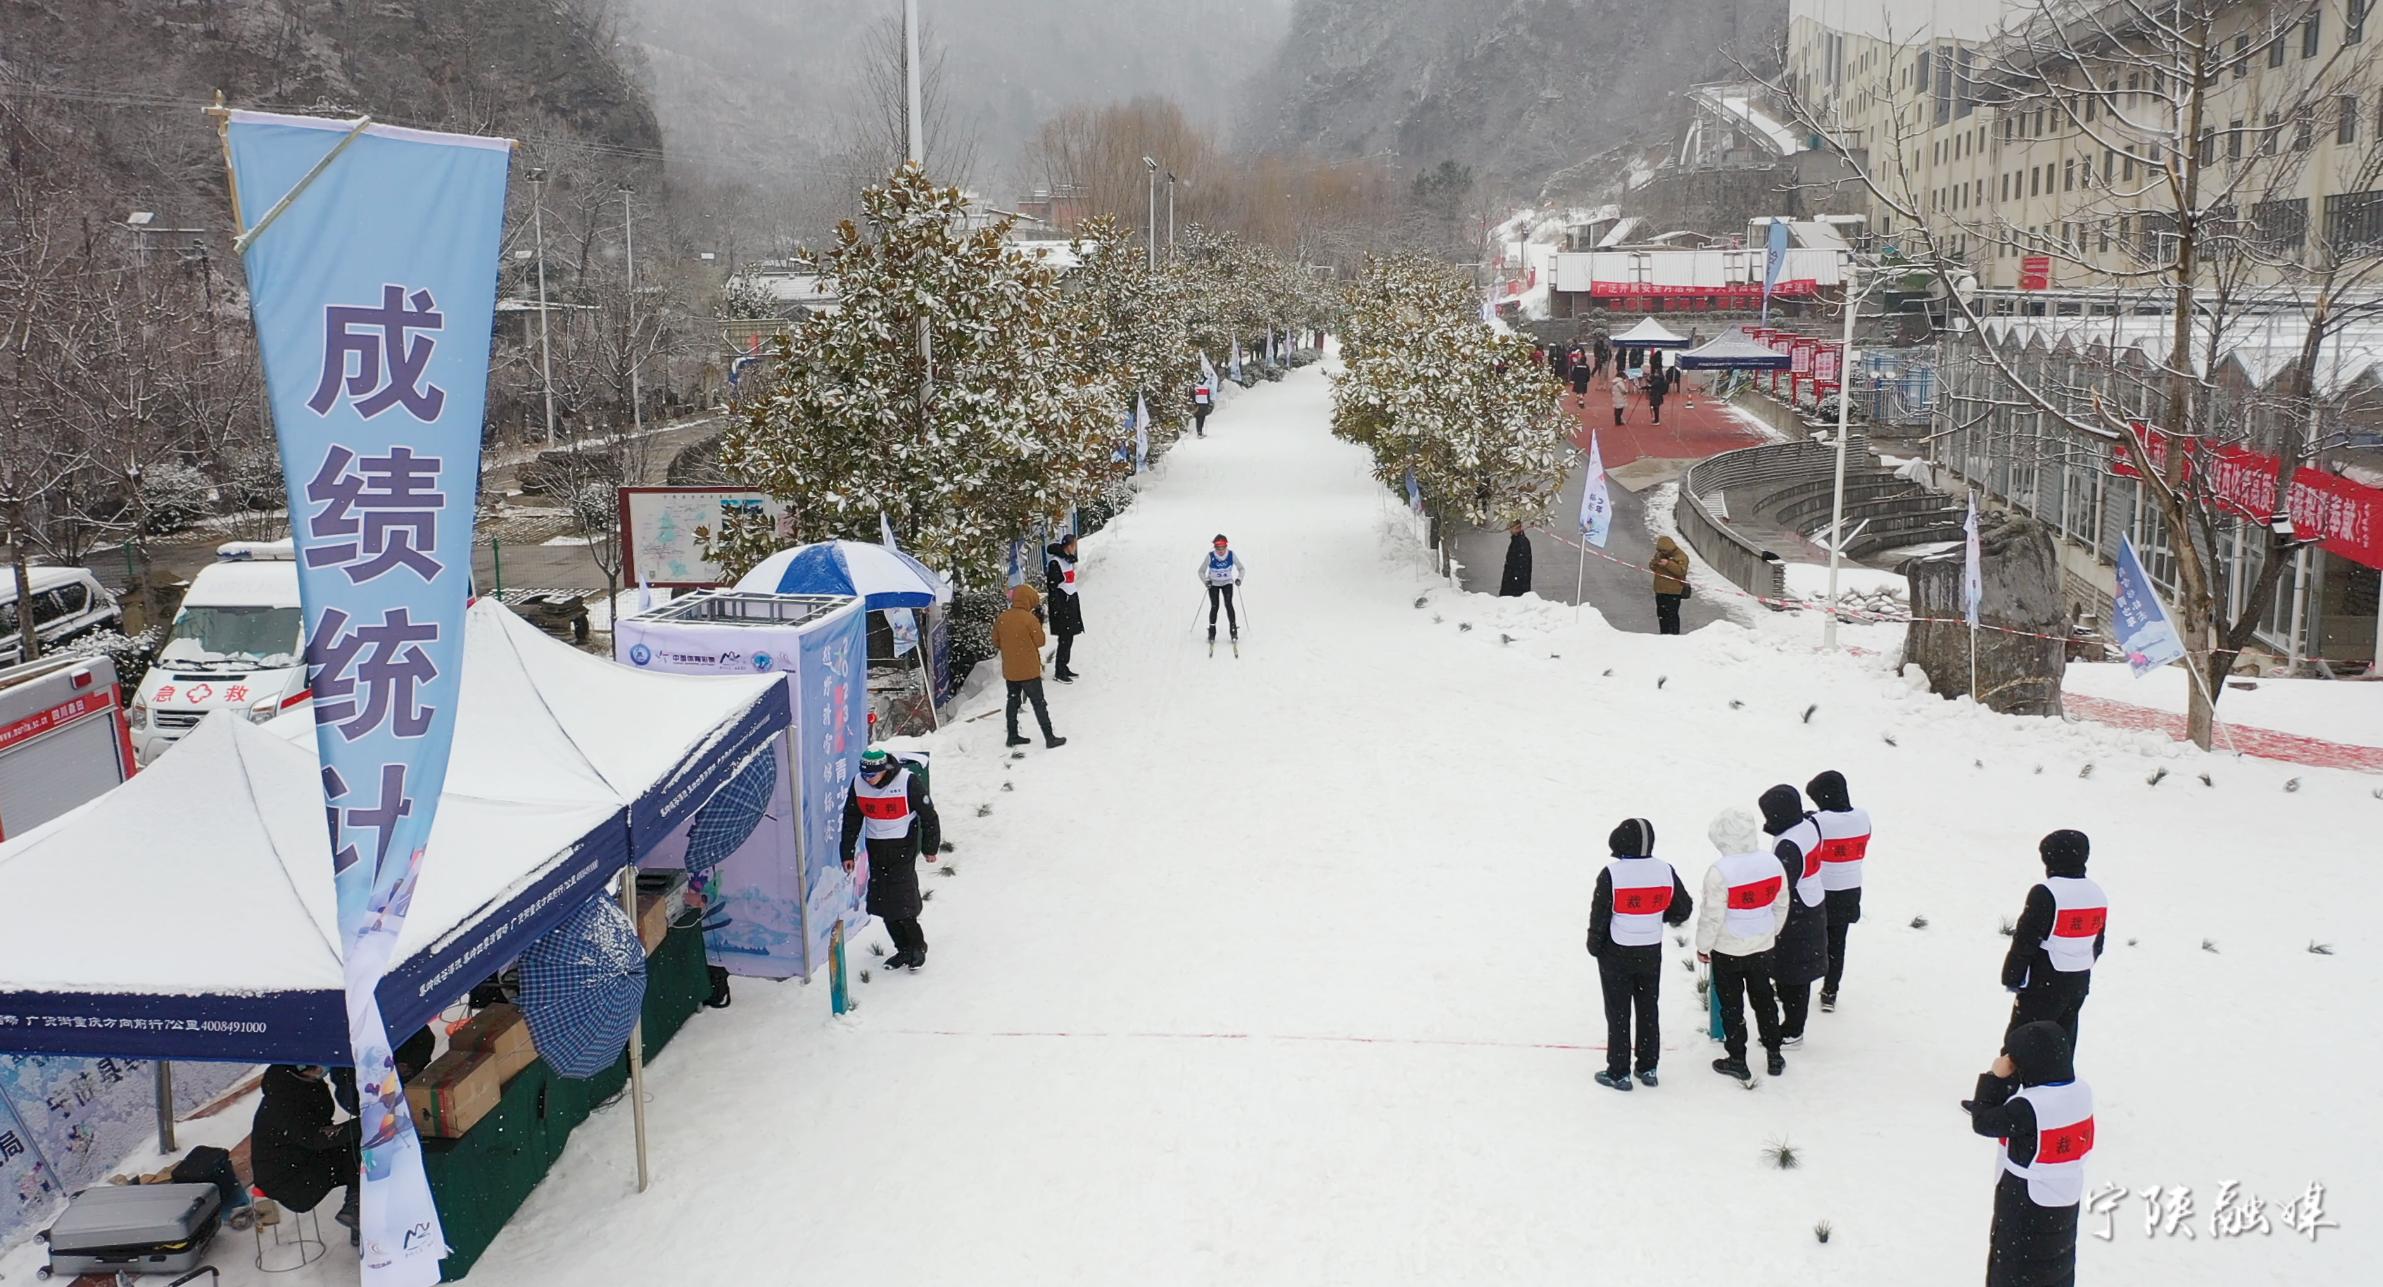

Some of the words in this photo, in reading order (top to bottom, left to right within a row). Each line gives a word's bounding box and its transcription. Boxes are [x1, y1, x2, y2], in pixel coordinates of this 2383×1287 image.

[305, 283, 445, 881] 成绩统计
[153, 684, 176, 703] 急
[225, 684, 250, 703] 救
[1627, 893, 1665, 909] 裁判
